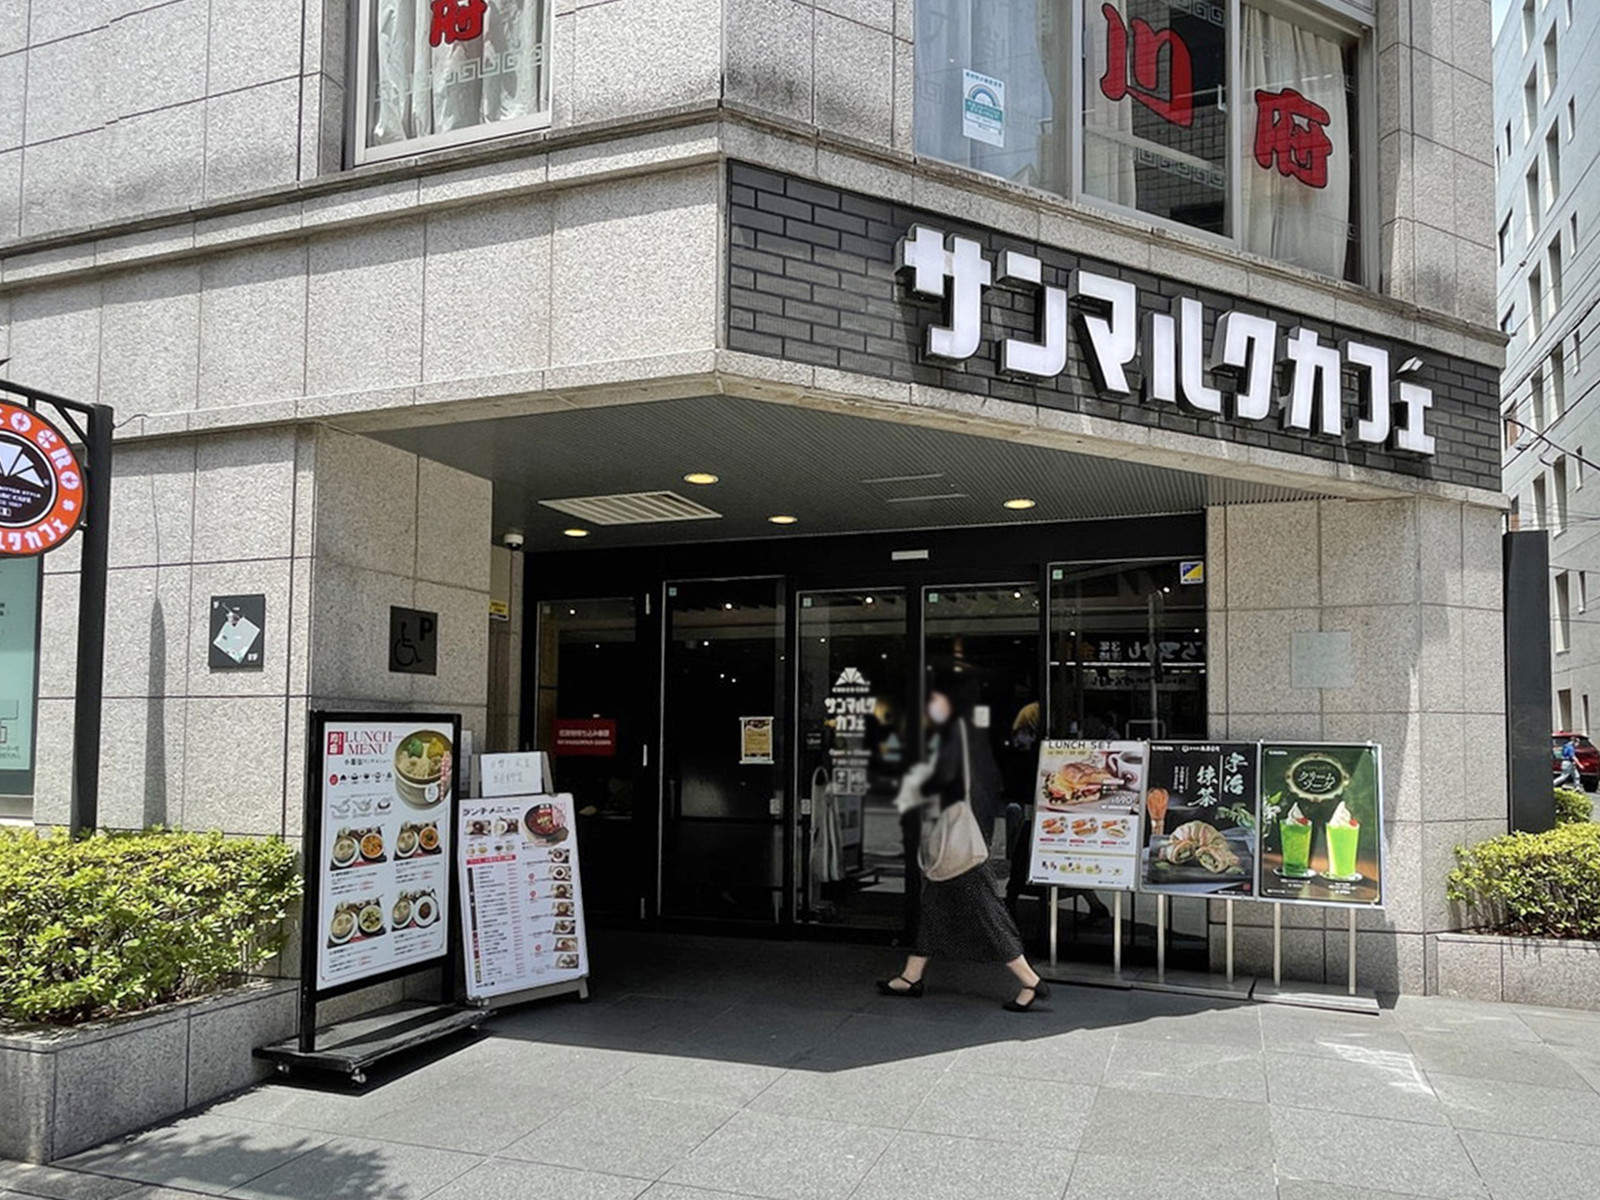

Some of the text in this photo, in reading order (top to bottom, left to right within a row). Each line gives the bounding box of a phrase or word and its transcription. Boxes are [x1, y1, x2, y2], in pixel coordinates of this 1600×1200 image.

[900, 225, 1436, 457] サンマルクカフェ
[420, 616, 433, 641] P
[824, 697, 877, 714] サンマルク
[835, 715, 866, 731] カフェ
[345, 731, 392, 744] LUNCH
[1048, 741, 1086, 749] LUNCH
[348, 743, 388, 756] MENU
